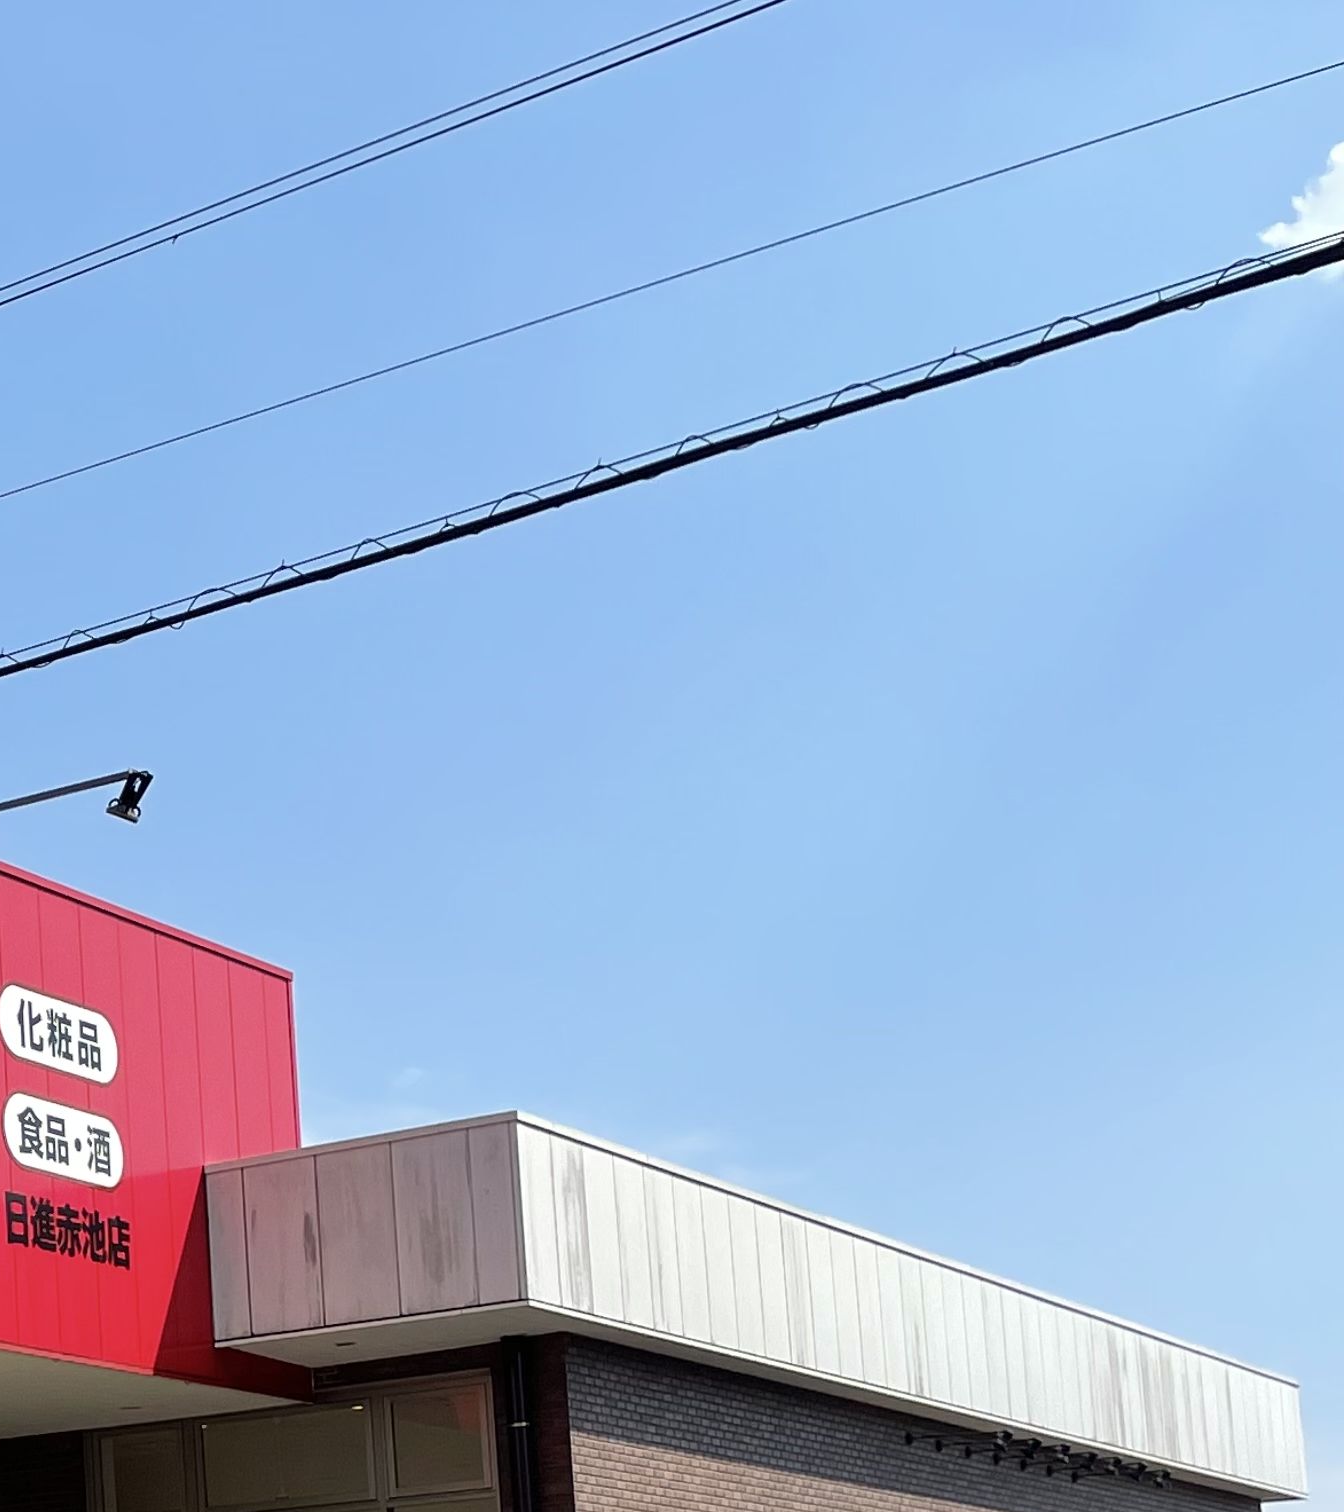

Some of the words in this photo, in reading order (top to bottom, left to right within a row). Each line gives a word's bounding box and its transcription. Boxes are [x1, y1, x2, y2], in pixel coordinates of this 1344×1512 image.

[17, 998, 102, 1072] 化粧品
[17, 1106, 112, 1178] 食品・酒
[5, 1190, 131, 1271] 日進赤池店
